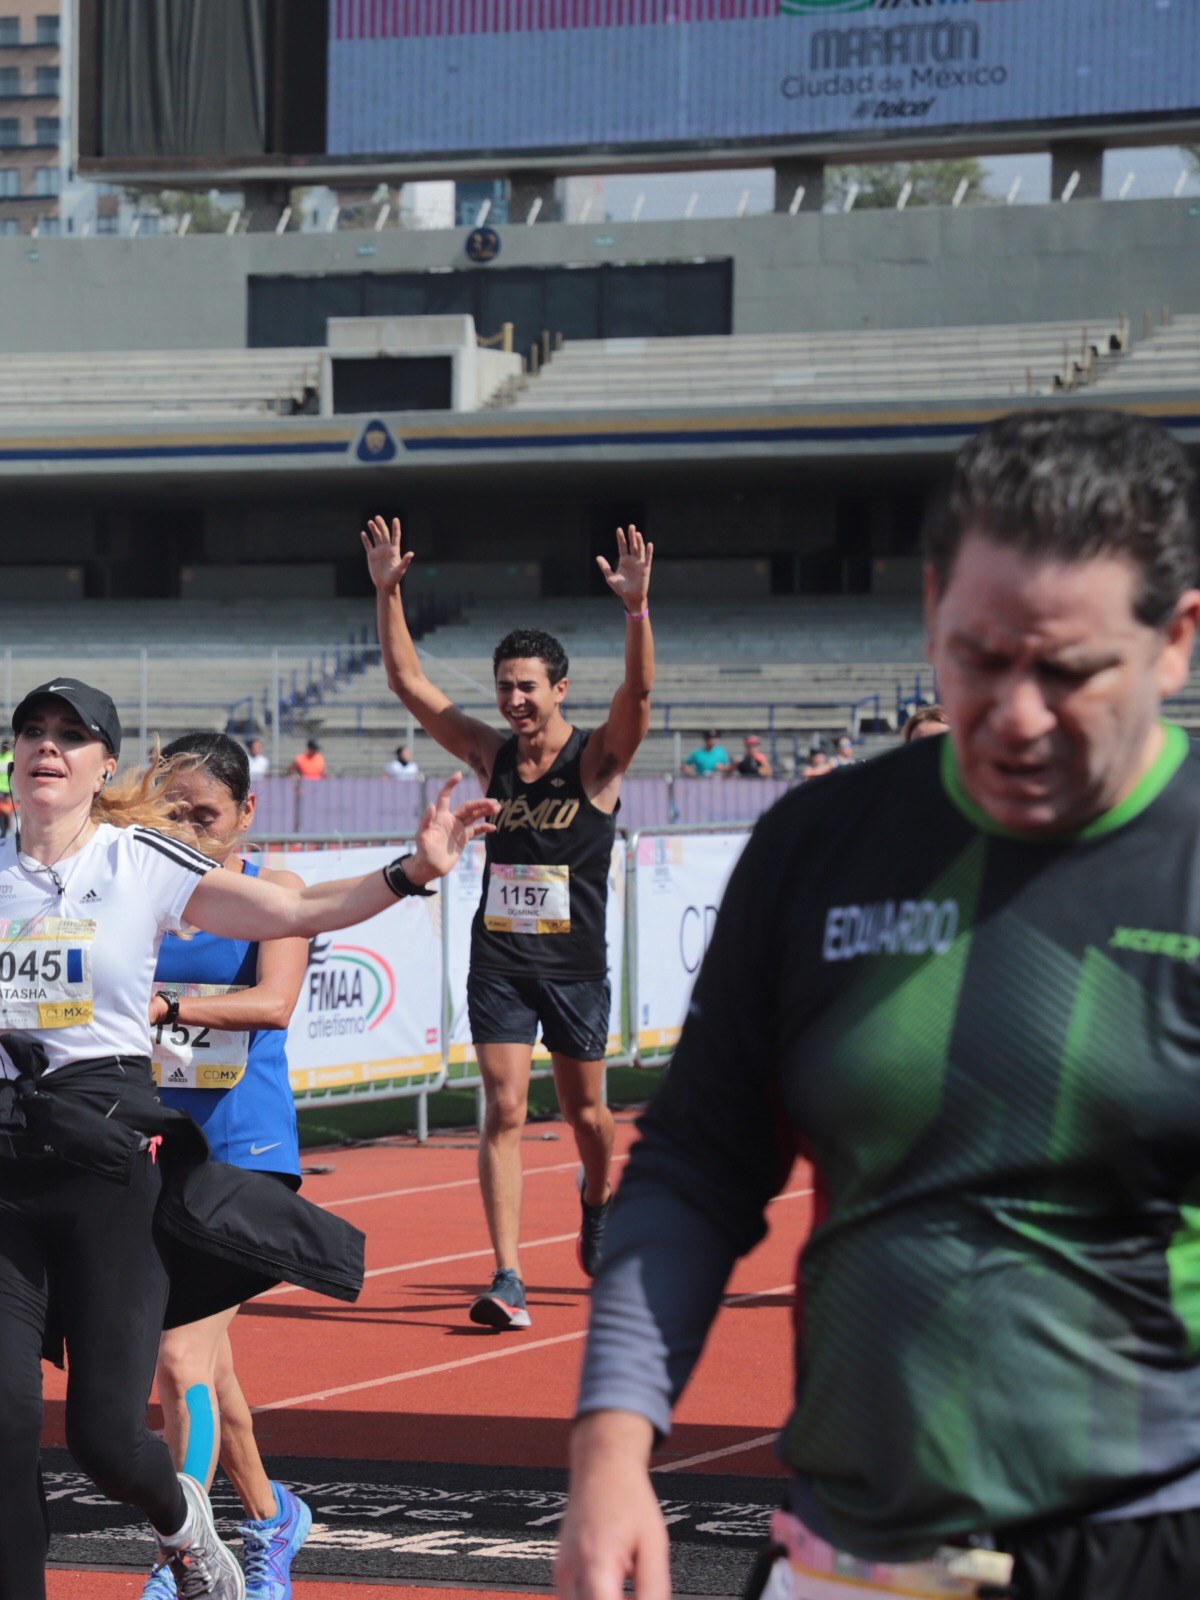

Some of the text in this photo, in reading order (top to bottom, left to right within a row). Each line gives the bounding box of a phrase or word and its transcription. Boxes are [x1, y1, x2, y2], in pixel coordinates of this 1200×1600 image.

[810, 18, 979, 70] MARATÓN
[781, 65, 1007, 99] Ciudad de México
[500, 885, 550, 907] 1157
[507, 908, 541, 917] DOMINIC
[822, 899, 959, 961] EDUARDO
[308, 968, 364, 1013] FMAA
[46, 1006, 83, 1020] CDMX
[307, 1014, 366, 1039] atletismo
[203, 1069, 238, 1081] CDMX
